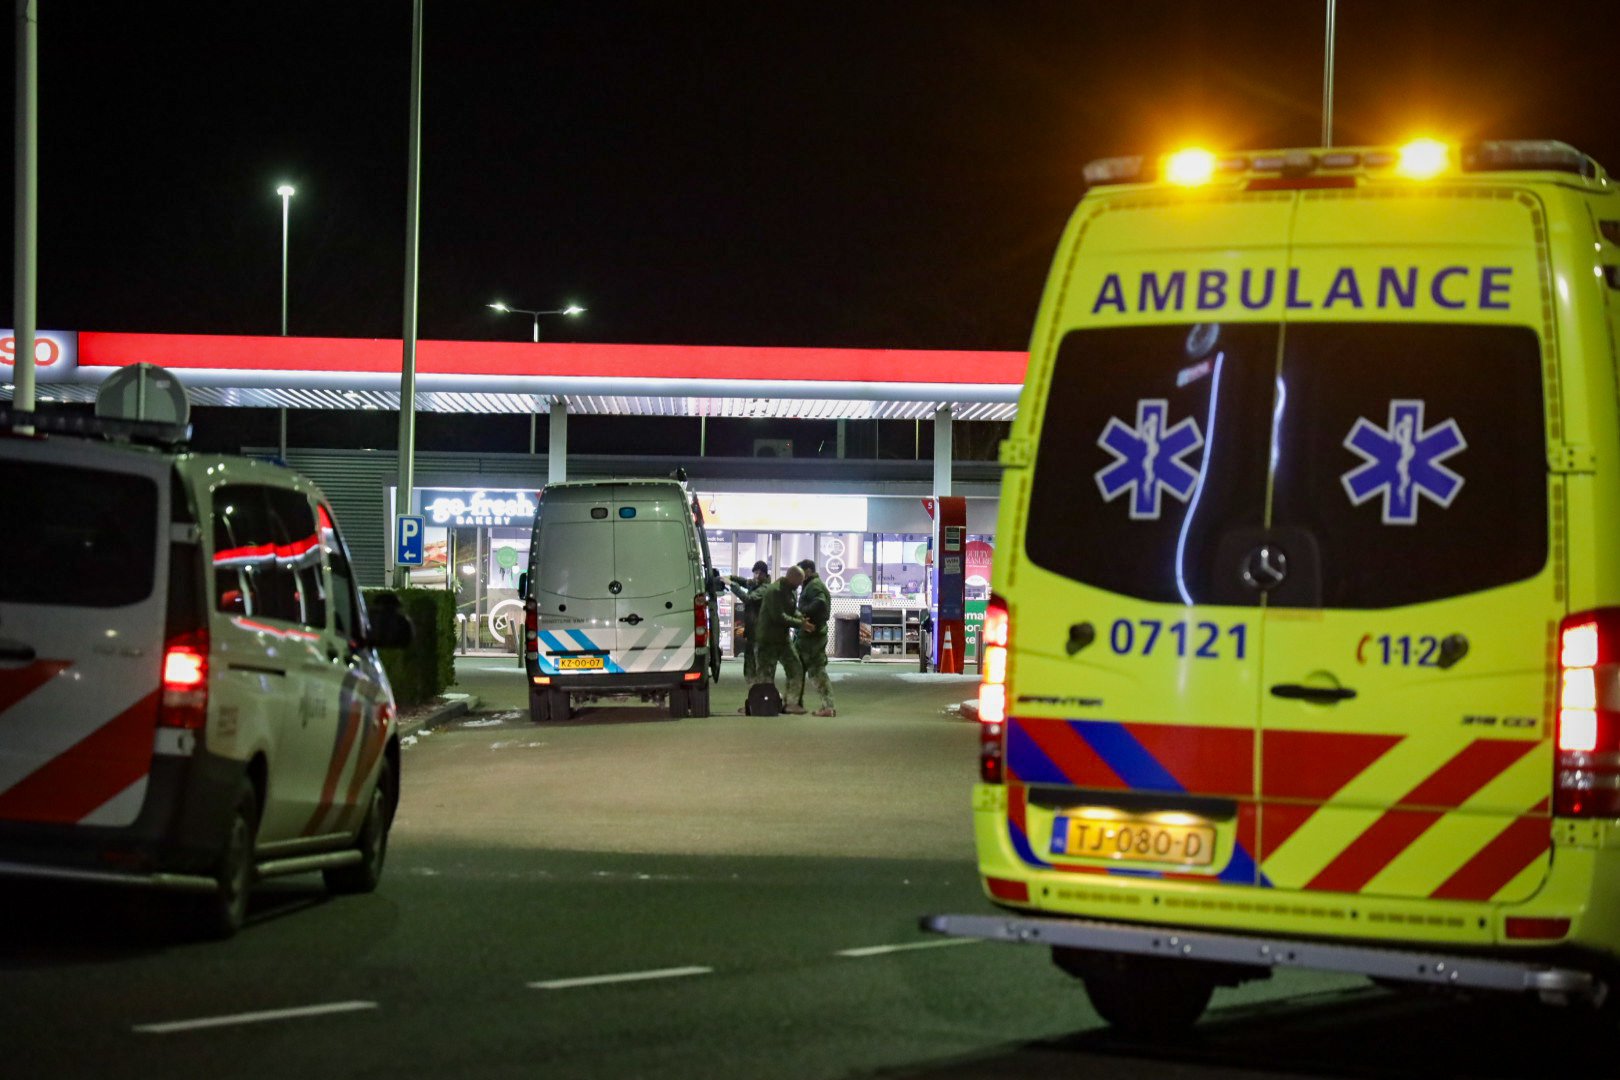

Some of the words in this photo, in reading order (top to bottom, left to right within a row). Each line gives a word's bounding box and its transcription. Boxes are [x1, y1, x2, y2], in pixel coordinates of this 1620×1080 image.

[1092, 266, 1513, 313] AMBULANCE
[402, 519, 419, 546] P
[456, 516, 511, 525] BAKERY
[1110, 618, 1247, 659] 07121
[561, 659, 601, 667] KZ-00-07
[1077, 824, 1201, 859] TJ-080-D
